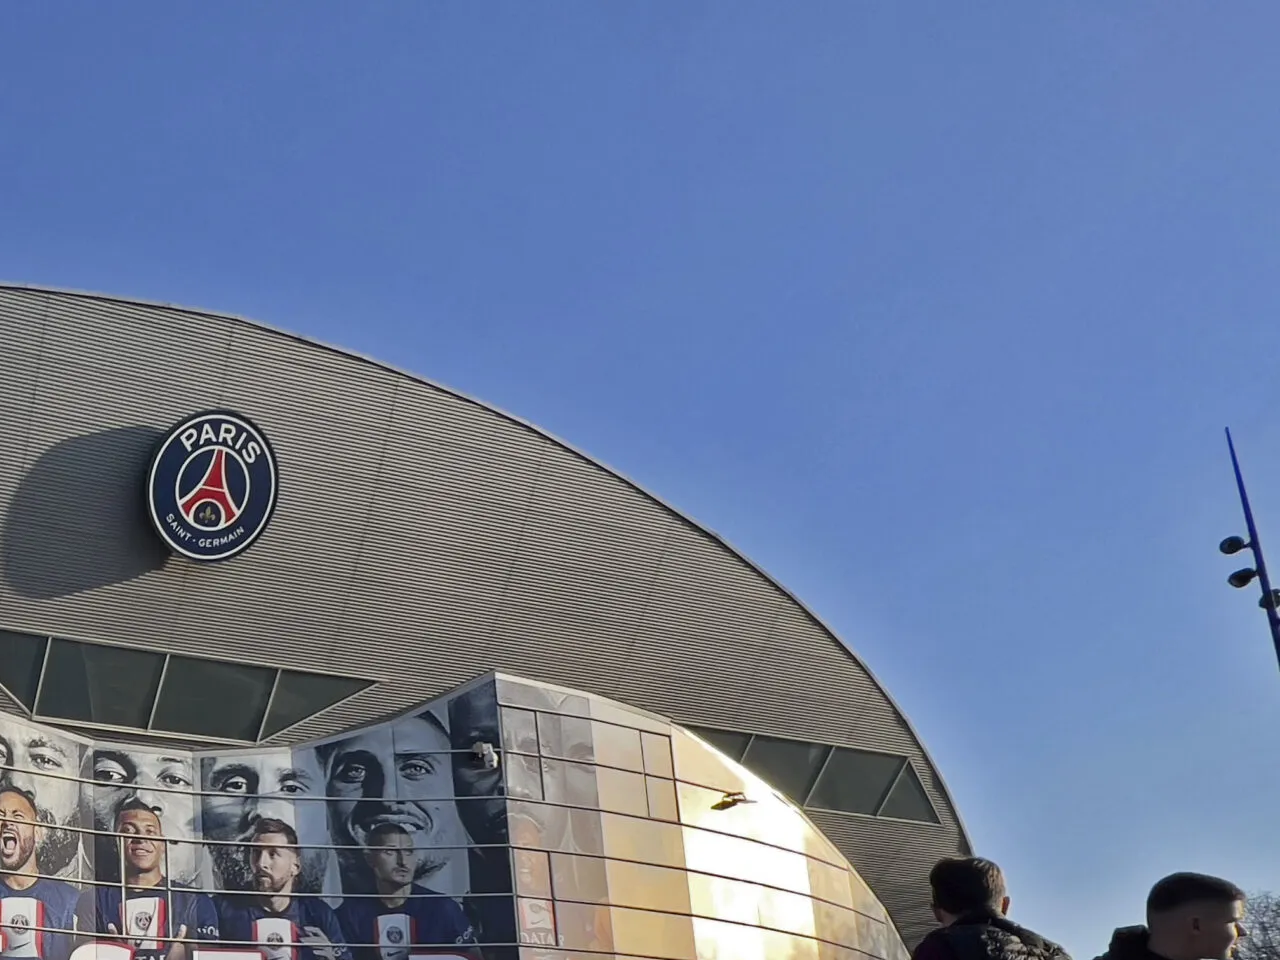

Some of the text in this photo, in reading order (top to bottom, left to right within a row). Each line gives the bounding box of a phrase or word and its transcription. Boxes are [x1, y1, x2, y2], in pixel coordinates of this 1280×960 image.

[180, 423, 261, 464] PARIS
[165, 513, 245, 548] SAINT GERMAIN
